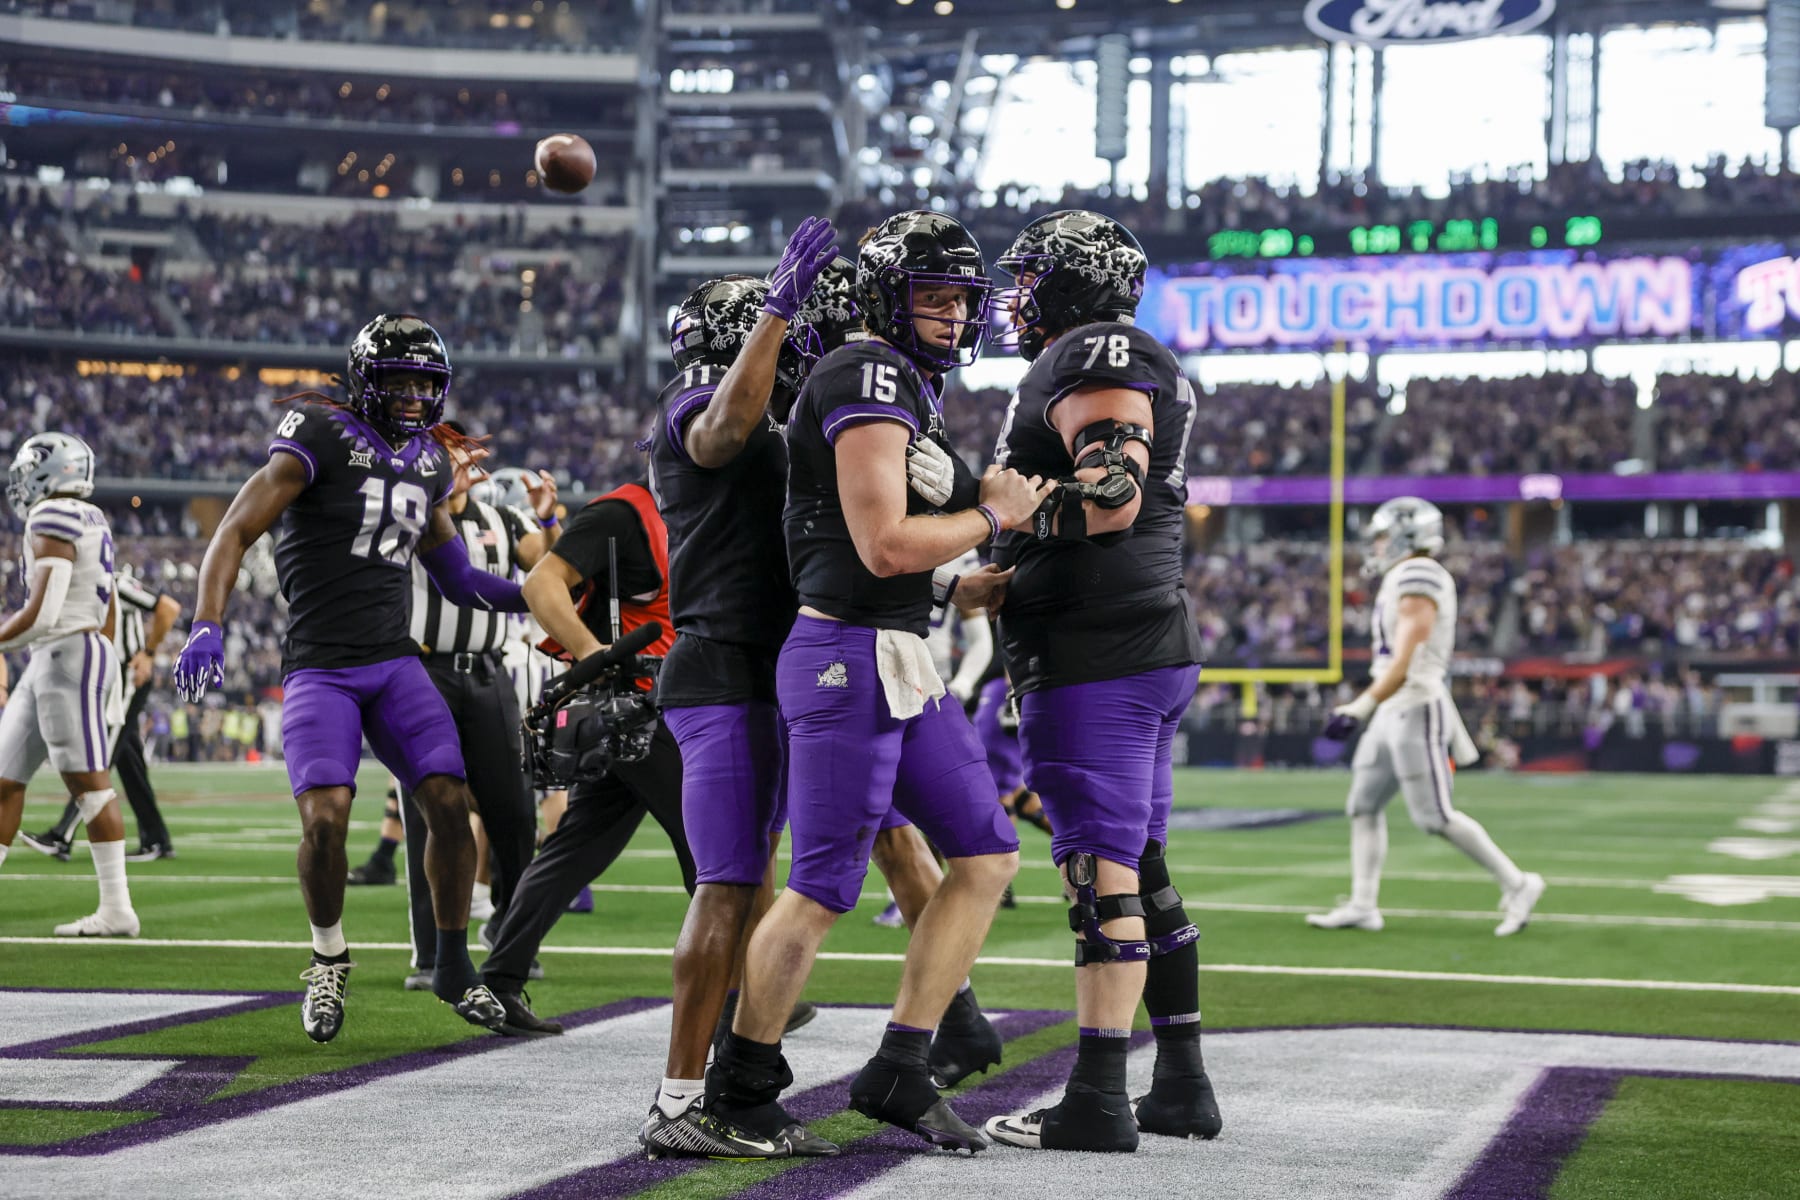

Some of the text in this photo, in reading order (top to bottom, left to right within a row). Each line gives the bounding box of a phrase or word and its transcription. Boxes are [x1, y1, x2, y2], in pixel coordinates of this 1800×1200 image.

[959, 265, 976, 278] TCU
[1166, 258, 1691, 347] TOUCHDOWN
[412, 353, 429, 363] TCU
[1082, 334, 1130, 370] 78
[684, 364, 710, 389] 11
[860, 362, 899, 404] 15
[276, 409, 306, 439] 18
[350, 476, 428, 567] 18
